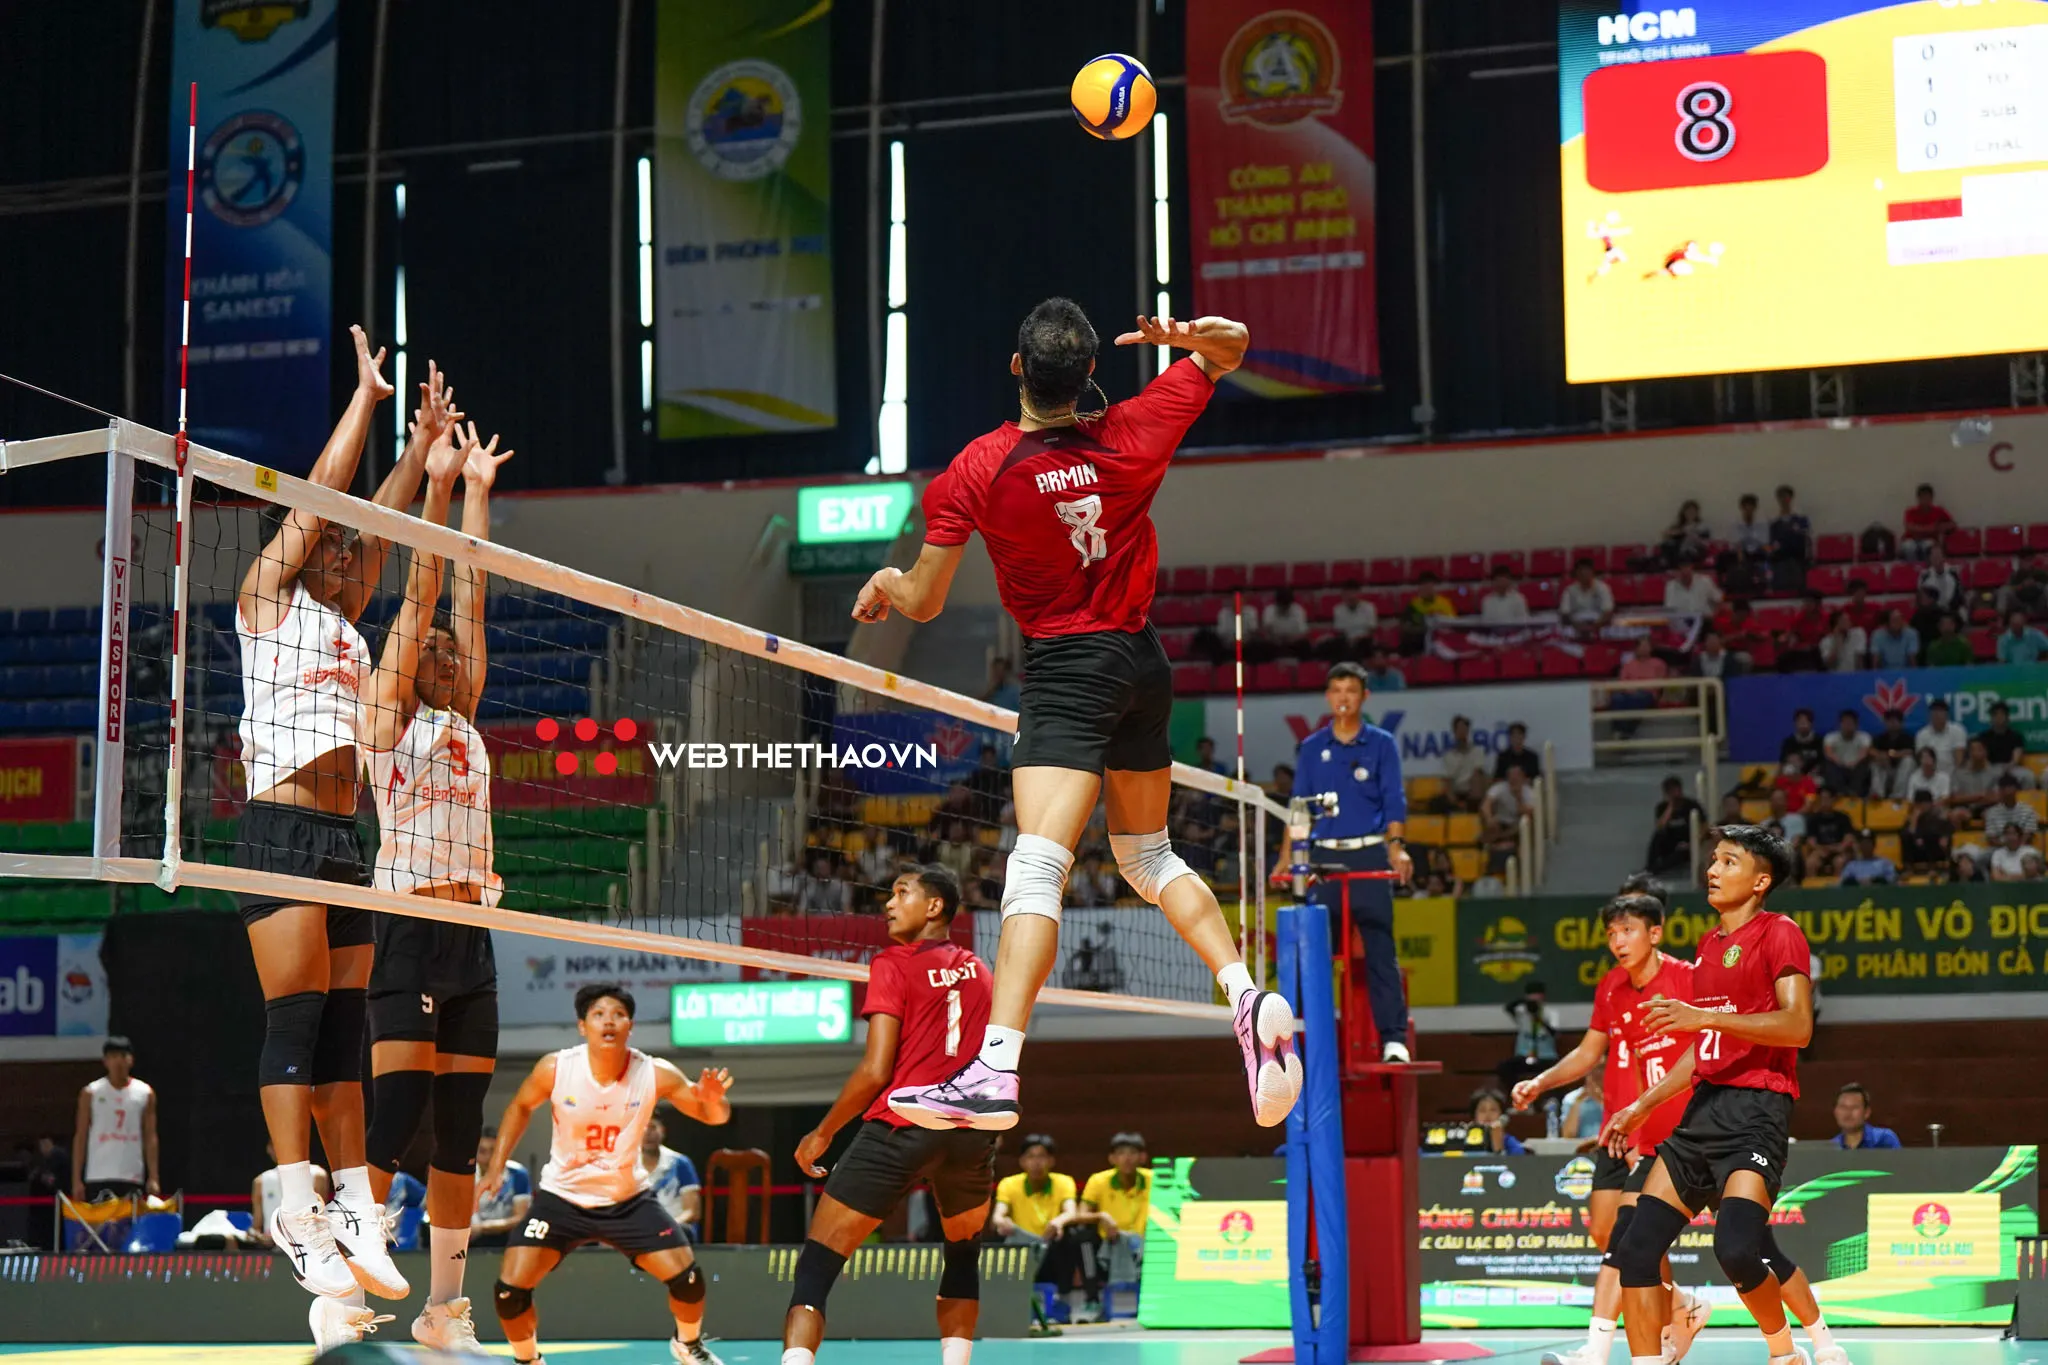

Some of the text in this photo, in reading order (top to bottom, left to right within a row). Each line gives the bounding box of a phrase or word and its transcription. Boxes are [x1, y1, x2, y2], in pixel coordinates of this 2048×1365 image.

[1597, 7, 1697, 46] HCM
[1674, 80, 1737, 163] 8
[203, 295, 295, 322] SANEST
[1988, 441, 2016, 473] C
[1035, 463, 1099, 494] ARMIN
[818, 494, 894, 534] EXIT
[1054, 494, 1108, 570] 8
[565, 956, 611, 974] NPK
[1856, 948, 1928, 979] PHÂN
[817, 987, 847, 1040] 5
[724, 1020, 766, 1043] EXIT
[1699, 1028, 1722, 1061] 21
[114, 1108, 127, 1131] 7
[585, 1123, 622, 1154] 20
[524, 1218, 550, 1241] 20
